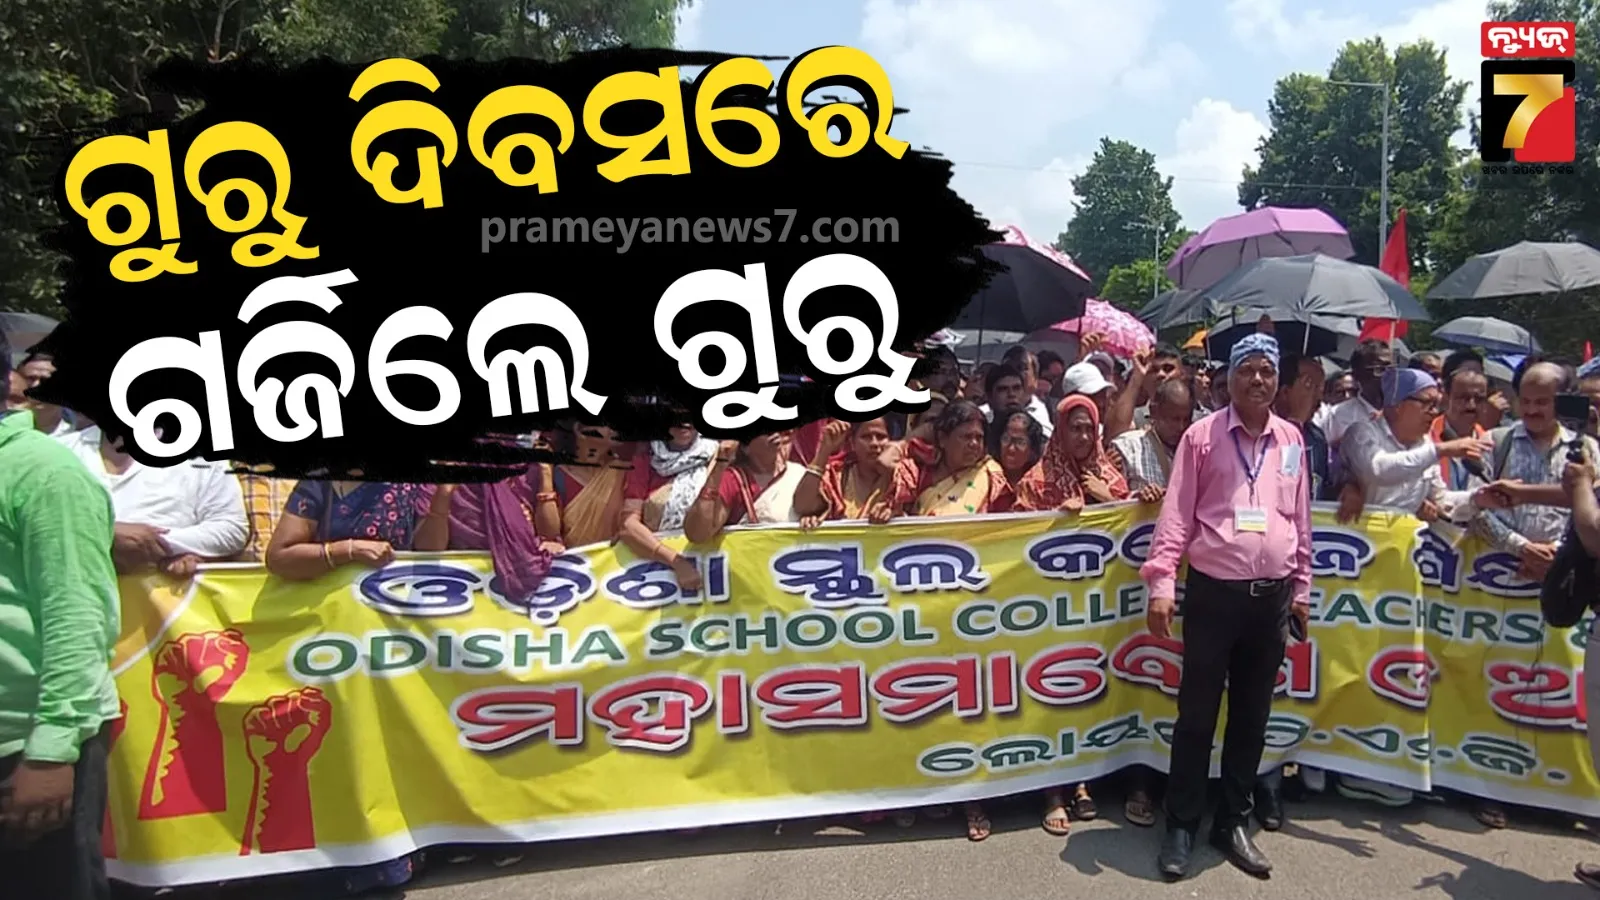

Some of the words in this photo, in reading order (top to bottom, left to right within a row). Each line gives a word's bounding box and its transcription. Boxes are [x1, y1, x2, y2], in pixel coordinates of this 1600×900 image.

[293, 630, 625, 677] ODISHA
[649, 608, 934, 655] SCHOOL
[956, 585, 1186, 631] COLLE
[1309, 592, 1543, 644] EACHERS
